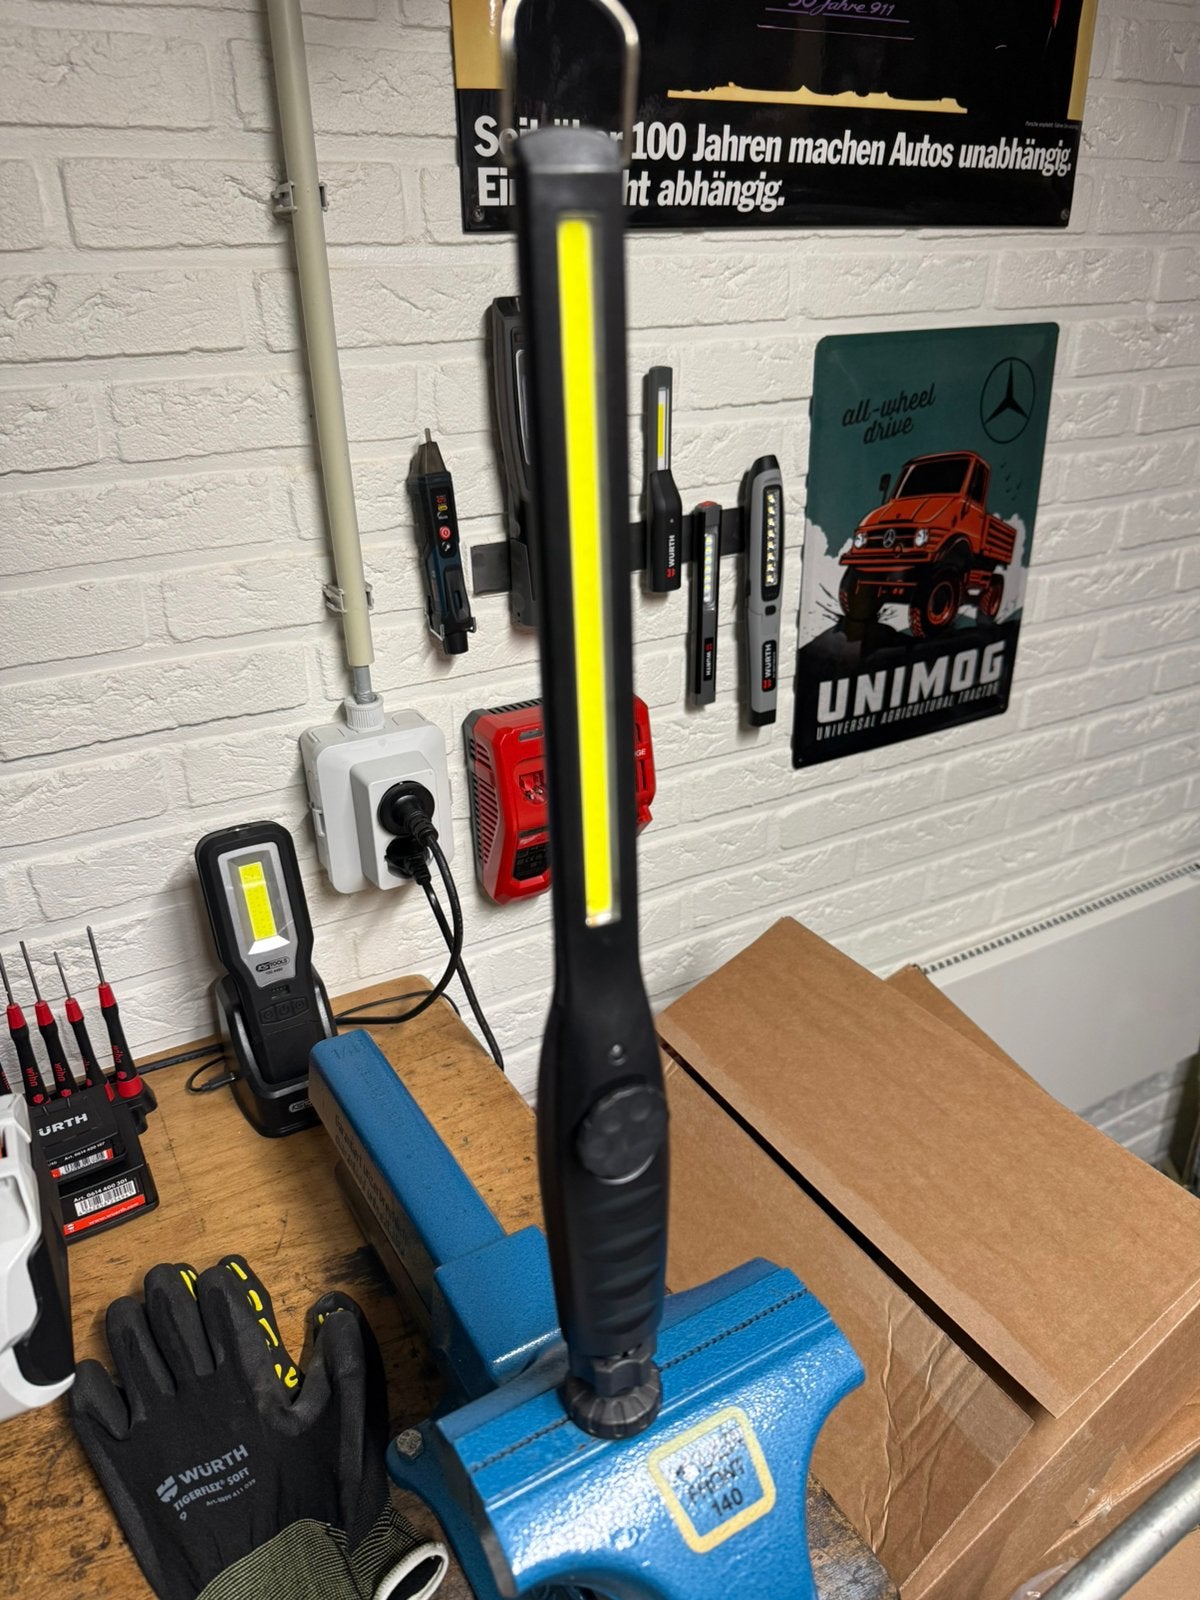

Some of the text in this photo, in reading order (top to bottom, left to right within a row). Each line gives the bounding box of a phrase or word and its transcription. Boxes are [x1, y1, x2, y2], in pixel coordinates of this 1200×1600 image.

[869, 2, 896, 17] 911
[631, 121, 687, 161] 100
[692, 123, 782, 163] Jahren
[788, 129, 886, 166] machen
[888, 131, 955, 169] Autos
[958, 136, 1072, 177] unabhängig.
[657, 169, 785, 213] abhängig.
[842, 382, 937, 427] all-wheel
[863, 416, 914, 445] drive
[816, 640, 1006, 724] UNIMOG
[816, 681, 1000, 741] UNIVERSAL AGRICULTURAL TRACTOR
[73, 1195, 86, 1203] Art.
[87, 1187, 102, 1197] 0614
[102, 1182, 116, 1191] 400
[178, 1444, 249, 1485] WÜRTH
[226, 1467, 250, 1486] SOFT
[179, 1511, 188, 1521] 9
[711, 1487, 744, 1516] 140
